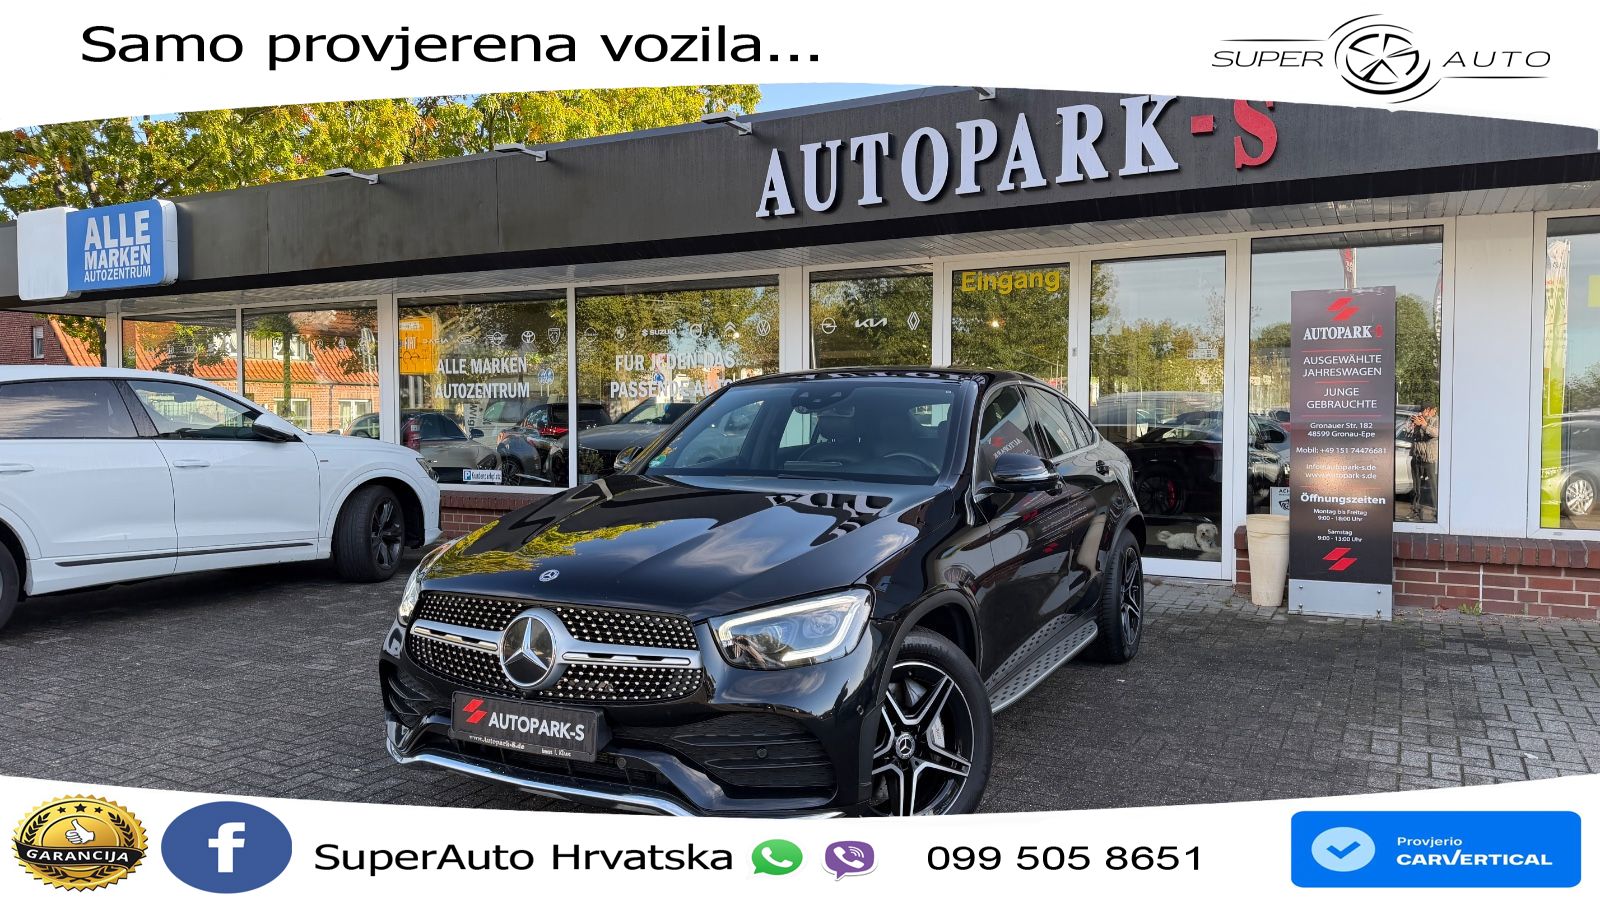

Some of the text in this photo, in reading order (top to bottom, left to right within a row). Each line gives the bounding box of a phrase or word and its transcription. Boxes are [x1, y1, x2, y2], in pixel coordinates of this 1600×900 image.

[84, 210, 151, 250] ALLE
[84, 244, 151, 270] MARKEN
[84, 265, 151, 283] AUTOZENTRUM
[961, 271, 1060, 294] Eingang
[649, 328, 677, 336] SUZUKI
[436, 356, 527, 375] ALLE MARKEN
[615, 350, 735, 372] FÜR JEDEN DAS
[1303, 354, 1382, 365] AUSGEWÄHLTE
[1303, 367, 1382, 378] JAHRESWAGEN
[434, 382, 530, 399] AUTOZENTRUM
[610, 379, 691, 399] PASSENDE
[1324, 387, 1360, 397] JUNGE
[1306, 399, 1377, 409] GEBRAUCHTE
[1331, 430, 1376, 438] Gronau-Epe
[1296, 446, 1319, 454] Mobil:
[1300, 492, 1386, 505] Öffnungszeiten
[488, 711, 585, 741] AUTOPARK-S
